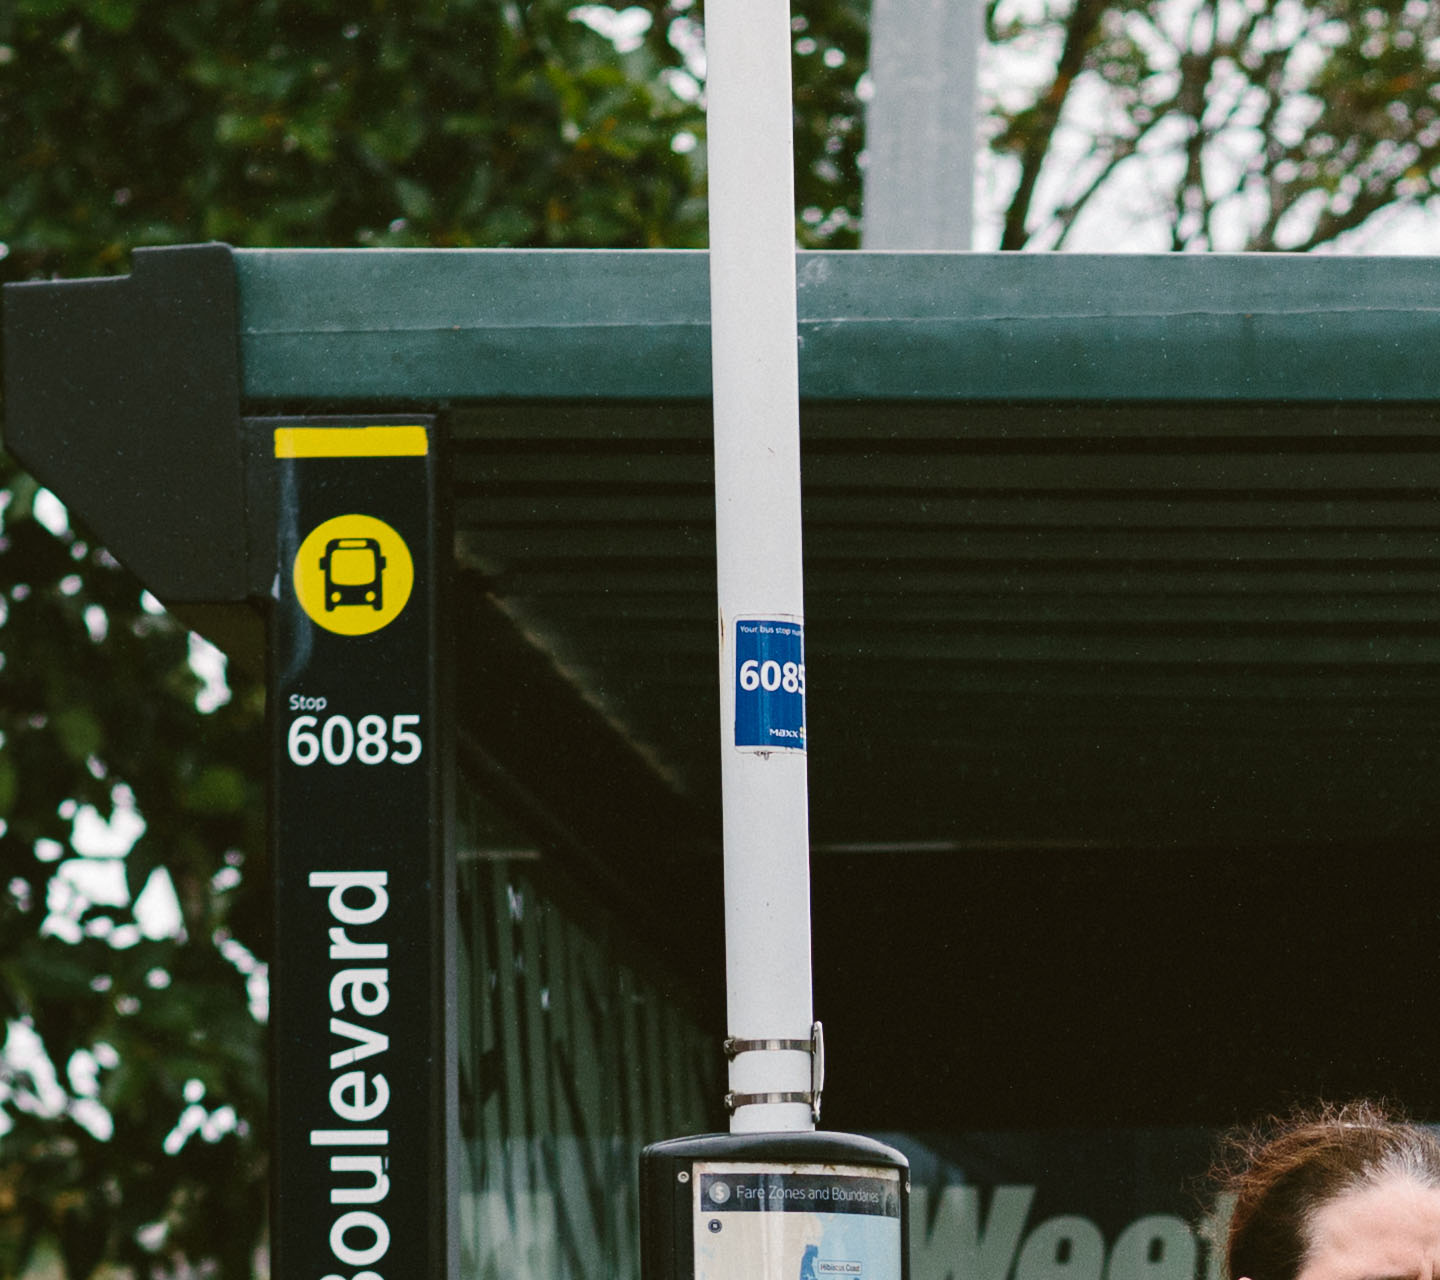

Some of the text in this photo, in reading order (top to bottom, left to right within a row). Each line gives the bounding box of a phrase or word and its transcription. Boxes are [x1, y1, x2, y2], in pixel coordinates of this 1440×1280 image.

[740, 625, 758, 634] Your
[760, 625, 774, 634] bus
[776, 627, 791, 636] stop
[289, 694, 327, 711] Stop
[288, 714, 422, 766] 6085
[736, 1184, 764, 1199] Fare
[768, 1185, 805, 1200] Zones
[808, 1185, 830, 1200] and
